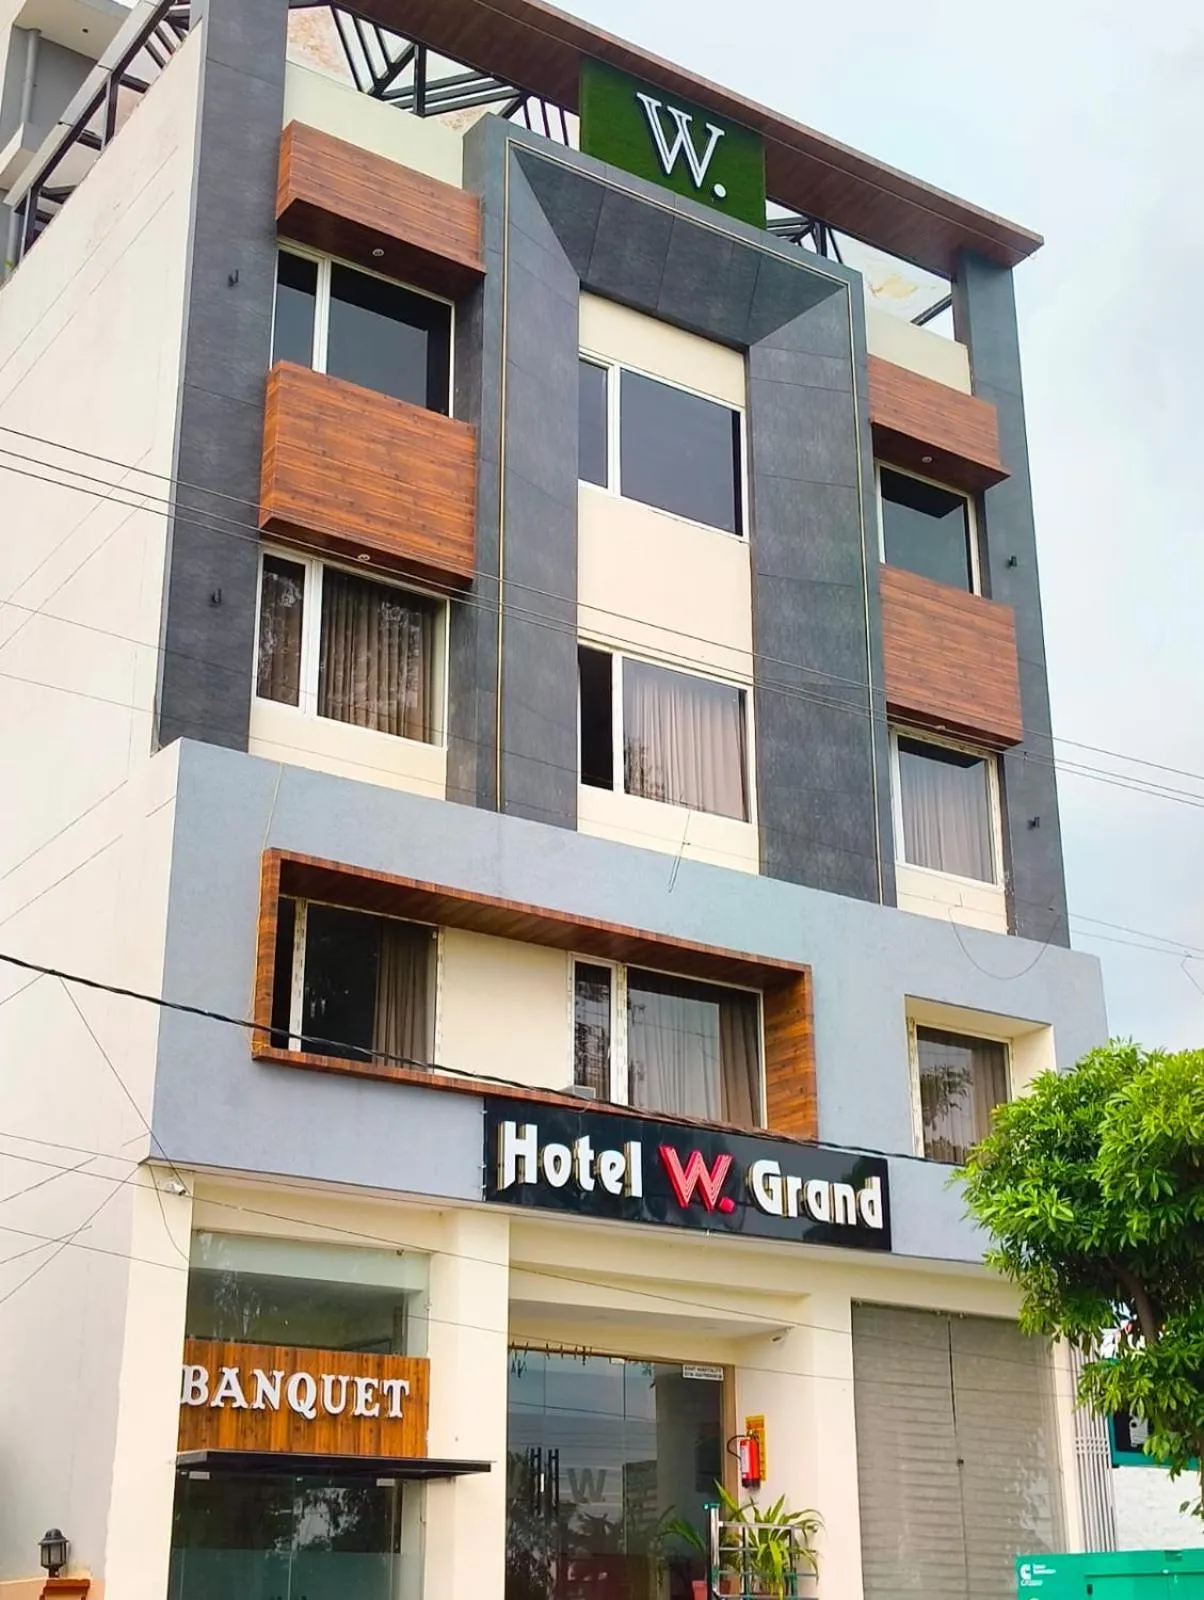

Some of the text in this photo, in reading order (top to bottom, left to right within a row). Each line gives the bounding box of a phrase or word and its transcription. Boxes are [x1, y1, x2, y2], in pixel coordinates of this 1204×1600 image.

[636, 91, 727, 198] W.
[498, 1120, 884, 1230] Hotel W. Grand
[180, 1364, 410, 1420] BANQUET
